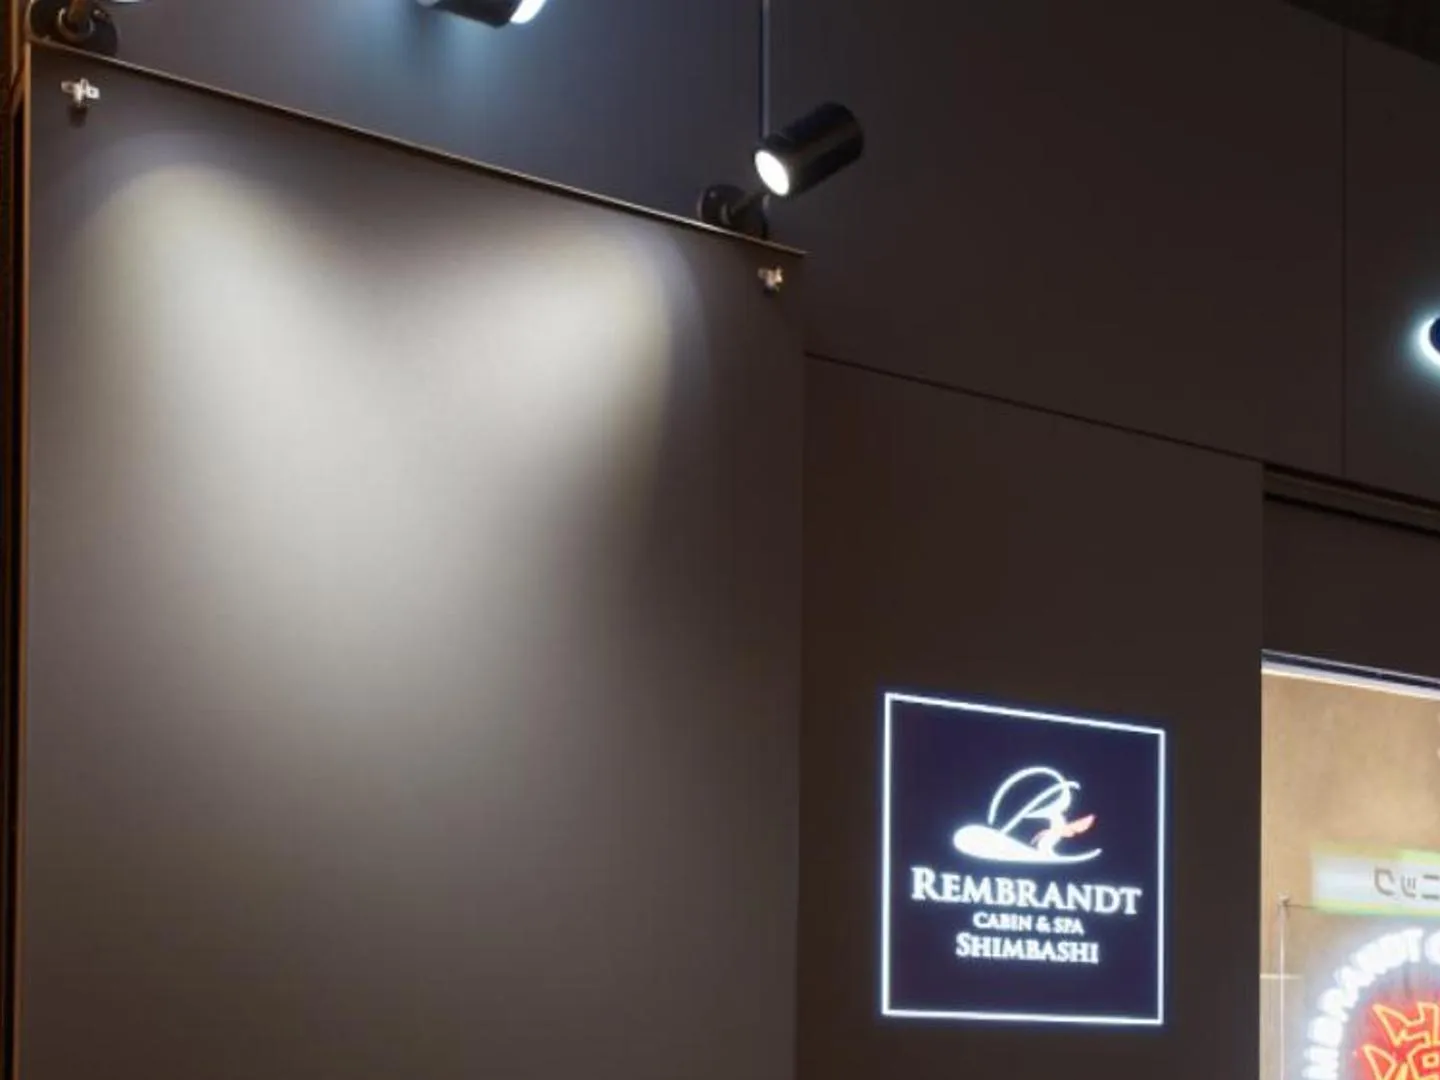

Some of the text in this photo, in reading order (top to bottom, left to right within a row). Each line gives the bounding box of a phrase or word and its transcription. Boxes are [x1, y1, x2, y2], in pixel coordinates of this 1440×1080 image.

[911, 866, 1142, 915] REMBRANDT
[972, 911, 1085, 935] CABIN & SPA
[955, 931, 1099, 964] SHIMBASHI
